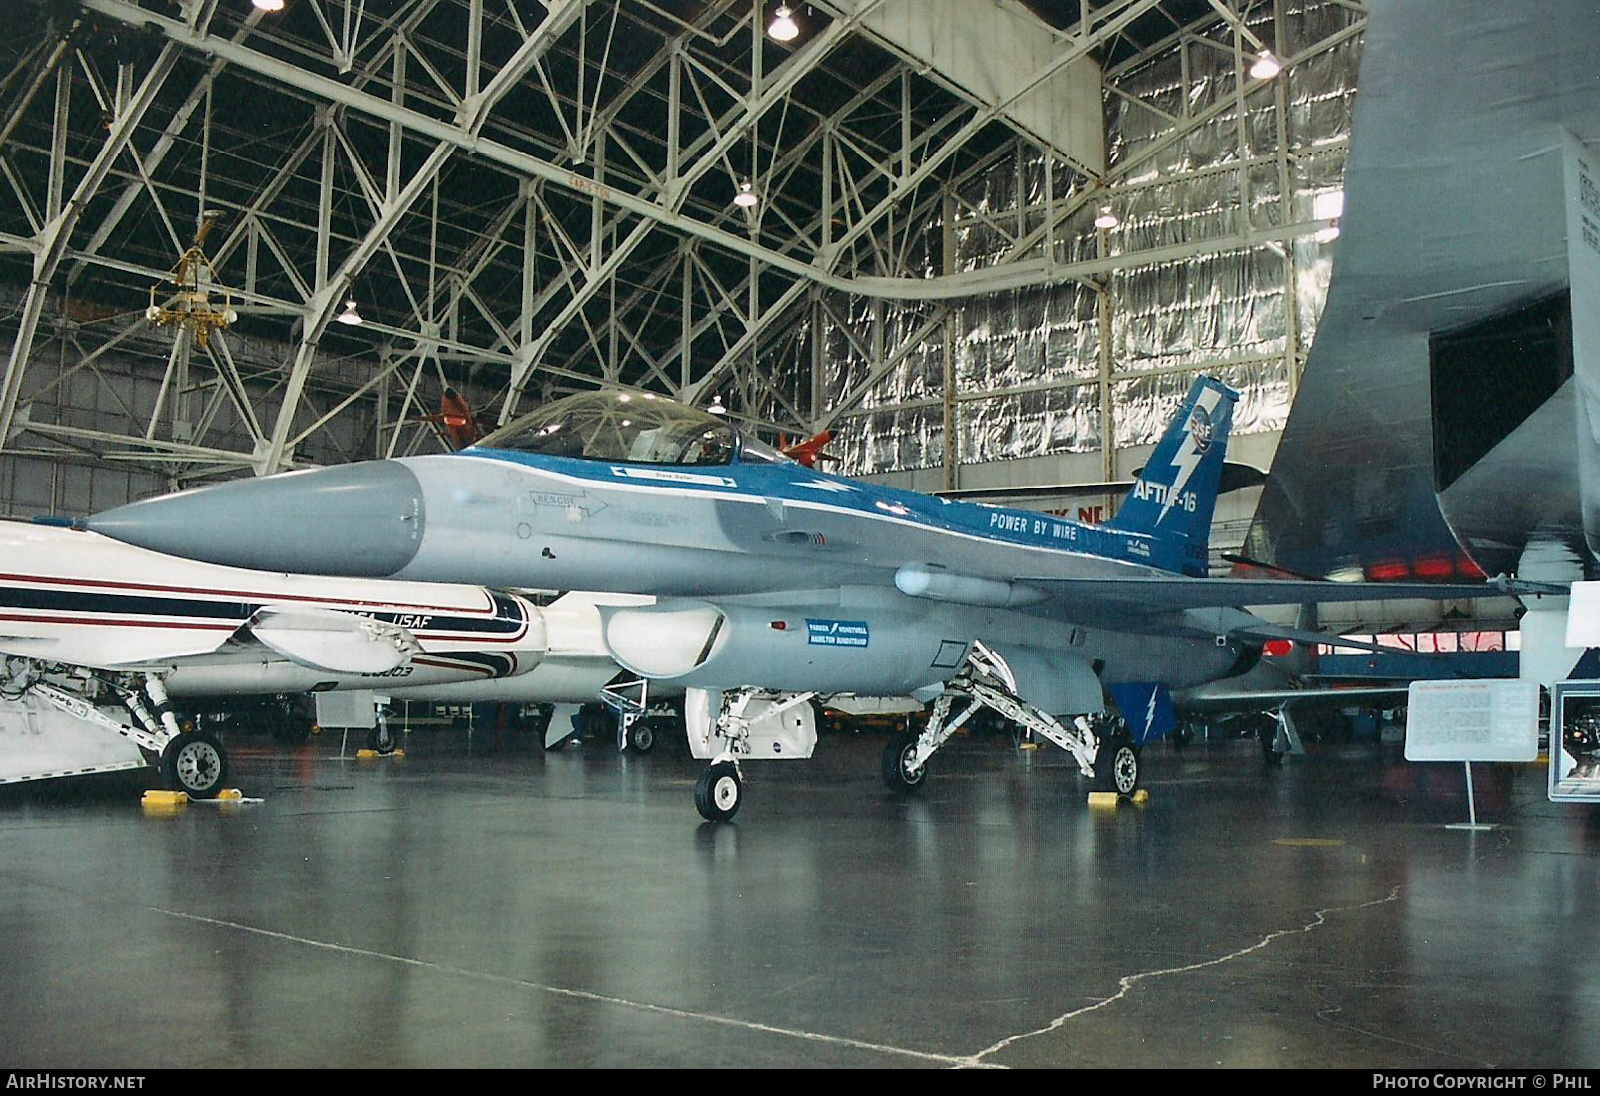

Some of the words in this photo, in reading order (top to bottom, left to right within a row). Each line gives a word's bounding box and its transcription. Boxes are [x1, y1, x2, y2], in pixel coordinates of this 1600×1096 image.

[1133, 479, 1166, 505] AFTI
[1171, 488, 1197, 513] F-16
[990, 512, 1028, 533] POWER
[1033, 520, 1048, 536] BY
[1052, 523, 1077, 541] WIRE
[393, 614, 432, 629] USAF
